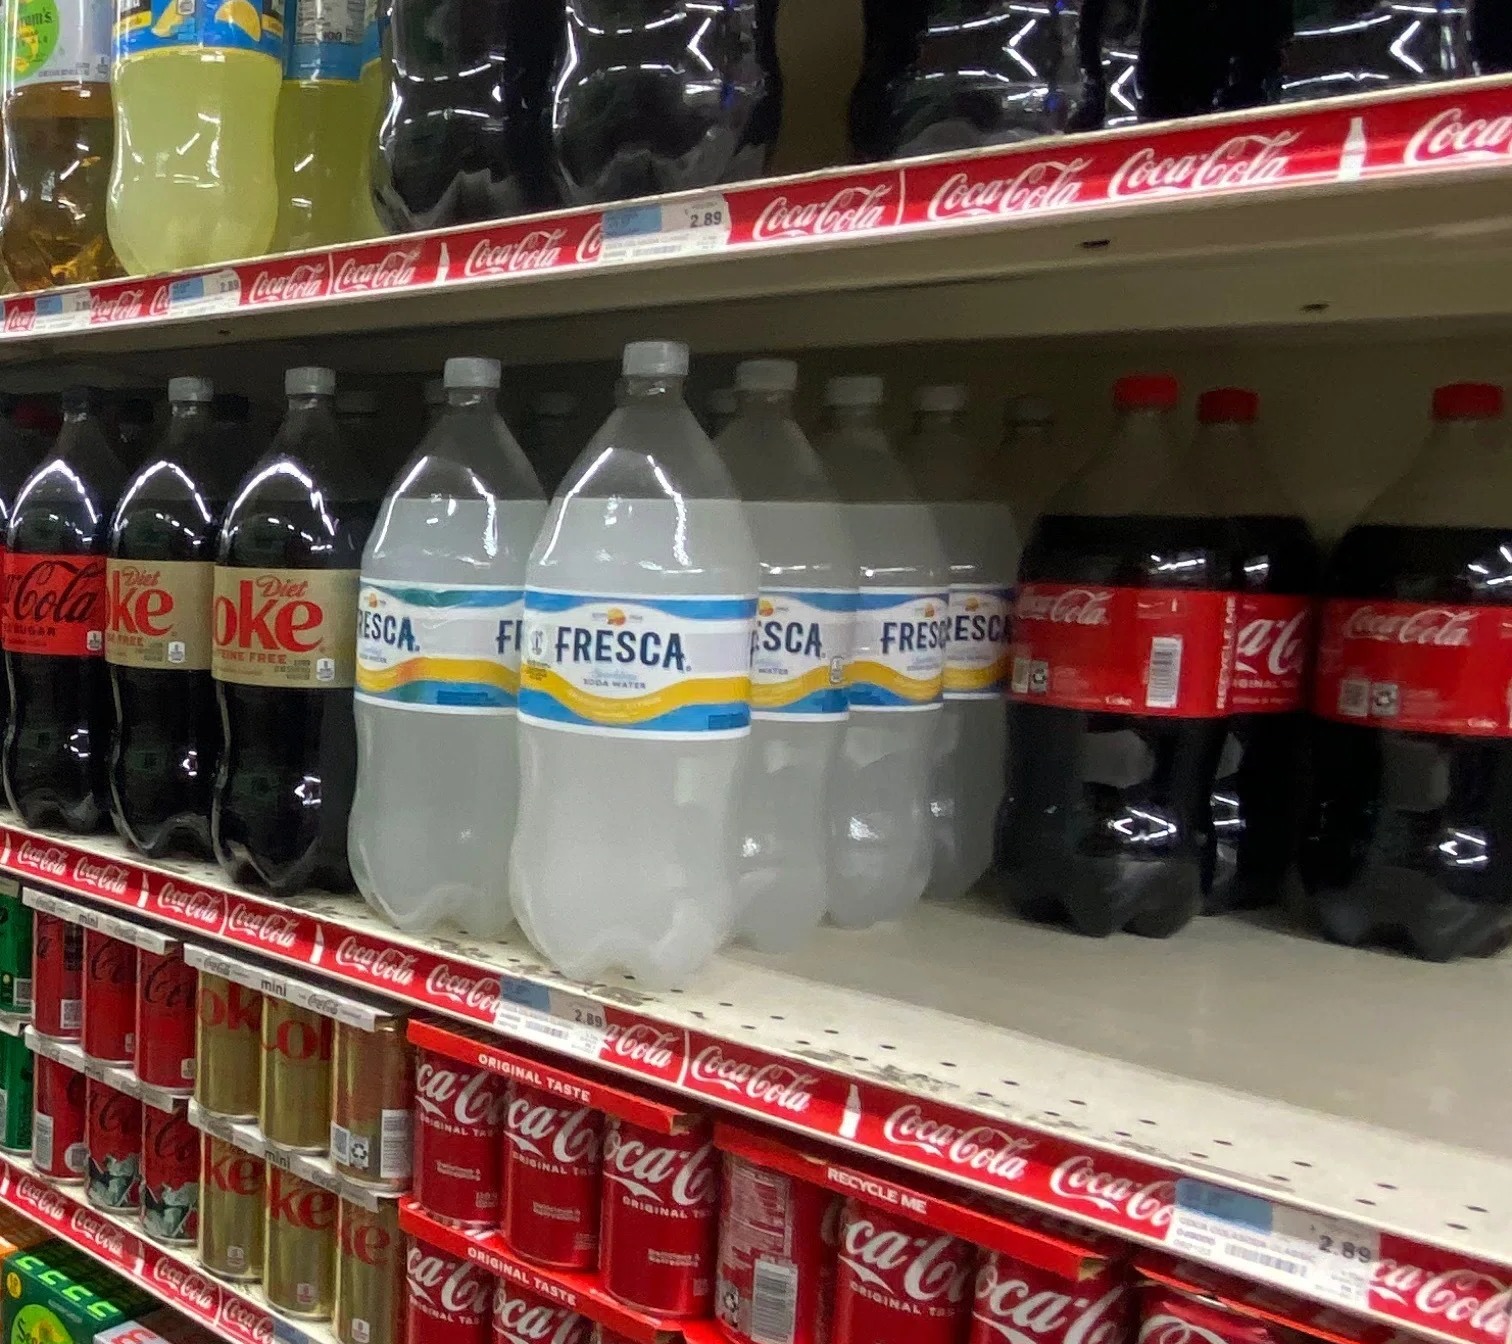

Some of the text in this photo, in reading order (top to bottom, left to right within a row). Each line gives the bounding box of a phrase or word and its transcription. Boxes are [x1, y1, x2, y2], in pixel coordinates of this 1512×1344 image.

[689, 209, 723, 229] 2.89
[255, 574, 309, 599] Diet
[214, 579, 324, 653] oke
[258, 652, 288, 666] FREE
[554, 625, 686, 672] FRESCA
[583, 677, 647, 691] SODA WATER
[260, 977, 288, 997] mini
[574, 1008, 603, 1029] 2.89
[478, 1053, 592, 1104] ORIGINAL TASTE
[826, 1166, 928, 1216] RECYCLE ME
[621, 1194, 688, 1220] ORIGINAL
[1317, 1233, 1372, 1264] 2.89
[467, 1246, 577, 1308] ORIGINAL TASTE
[848, 1280, 923, 1315] ORIGINAL
